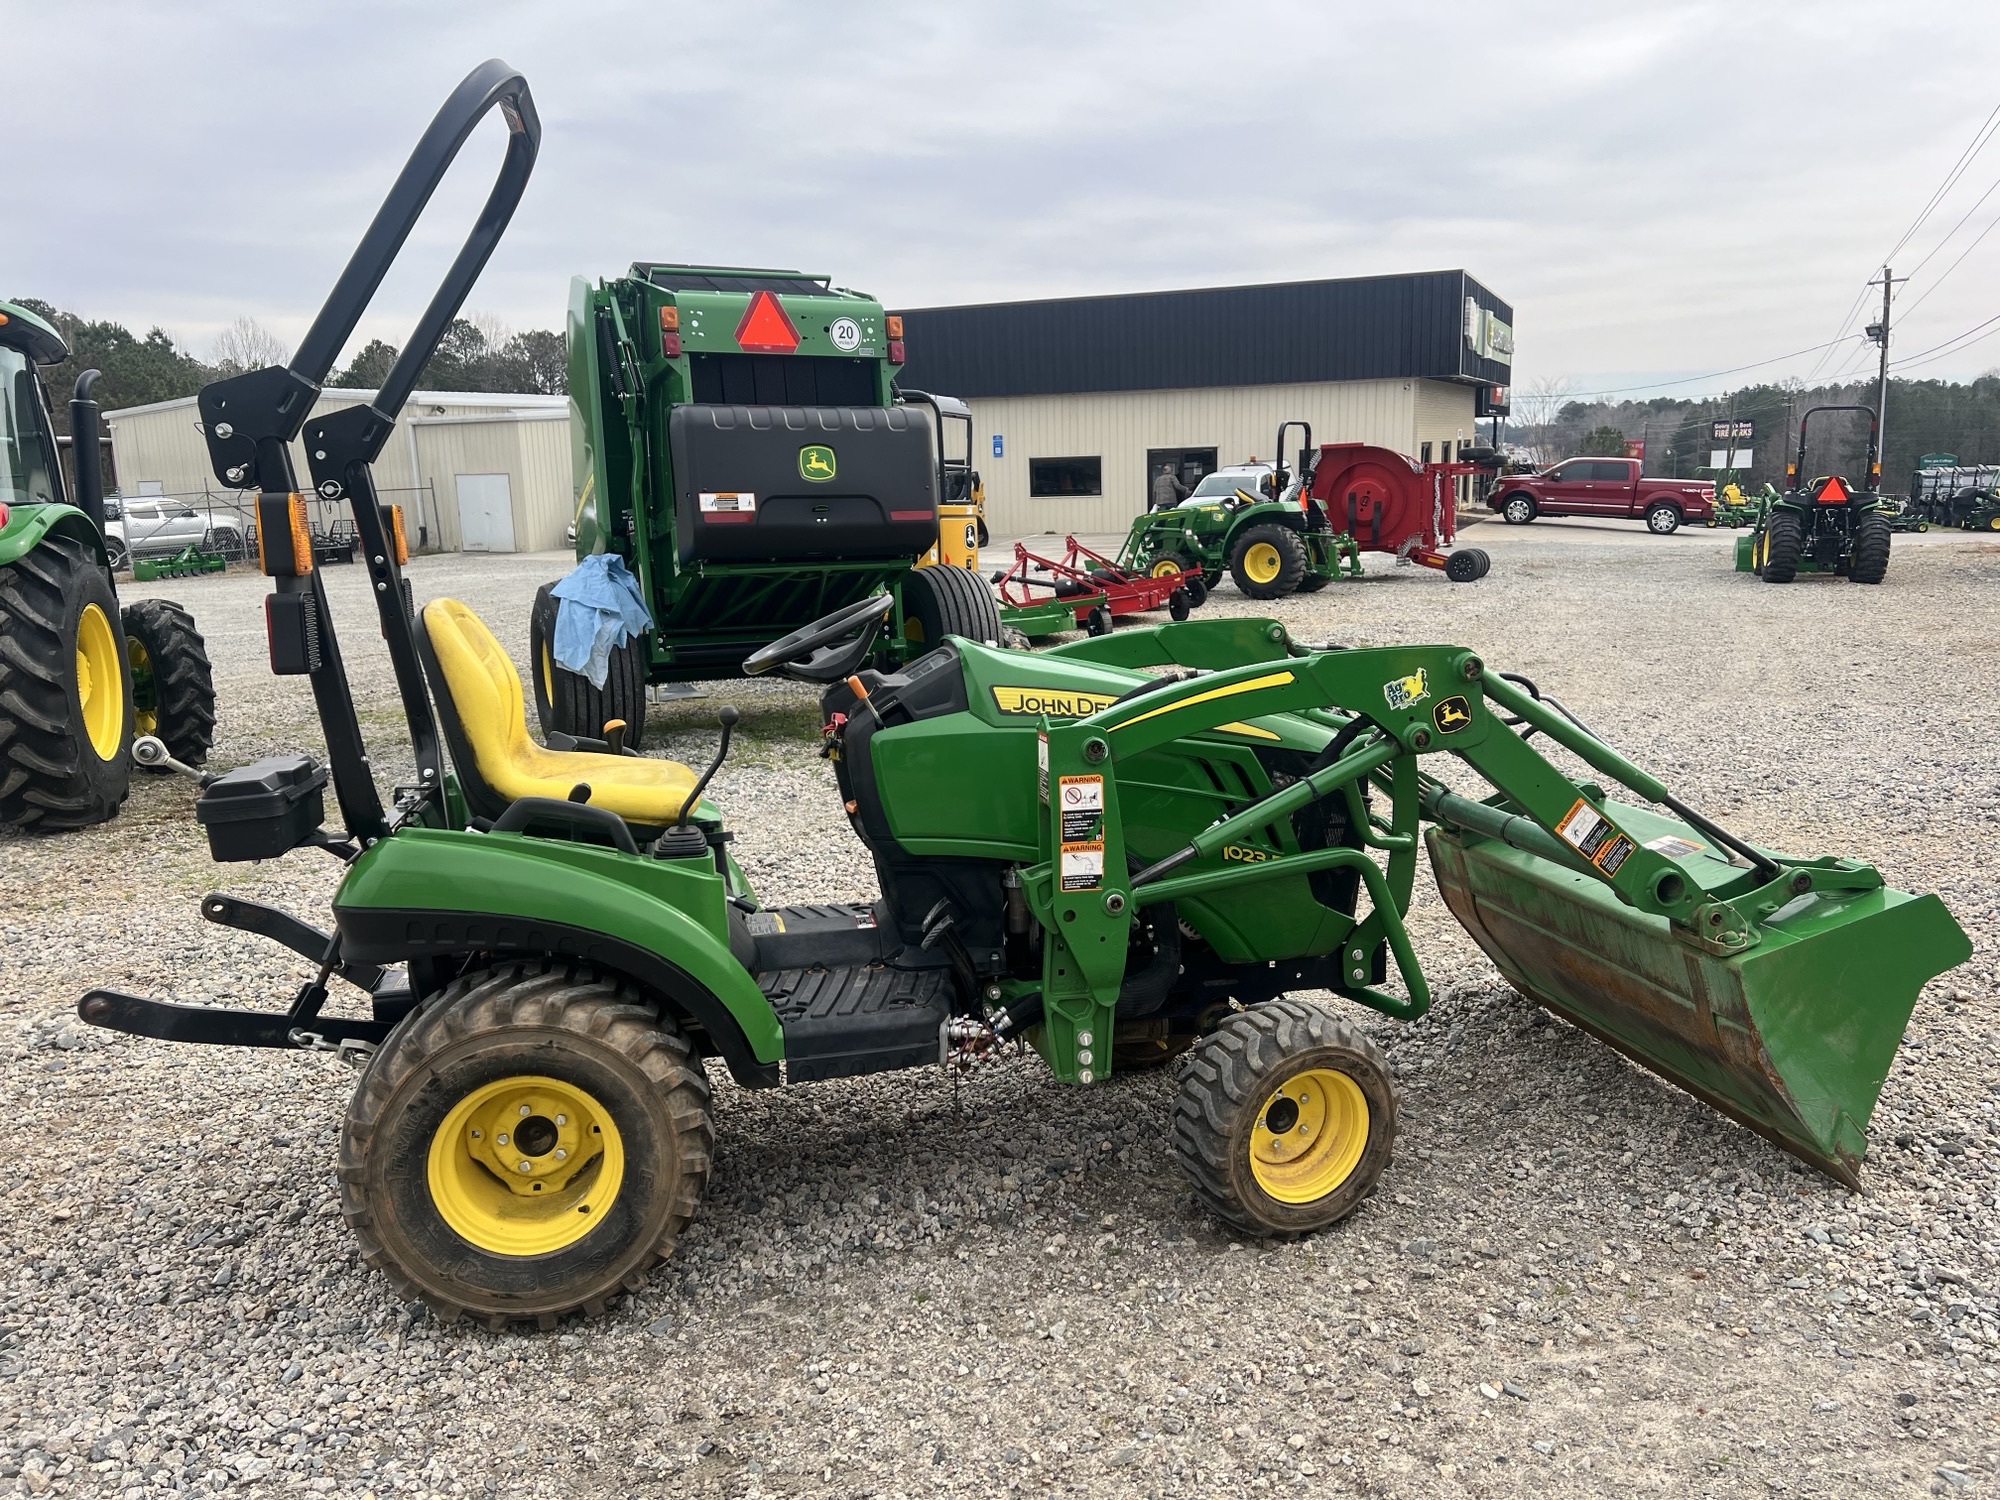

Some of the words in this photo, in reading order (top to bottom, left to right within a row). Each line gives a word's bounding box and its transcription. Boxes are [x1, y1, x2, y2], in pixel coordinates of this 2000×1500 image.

[838, 325, 853, 339] 20
[1013, 694, 1071, 713] JOHN
[1390, 689, 1410, 706] Pro
[1070, 844, 1102, 852] WARNING
